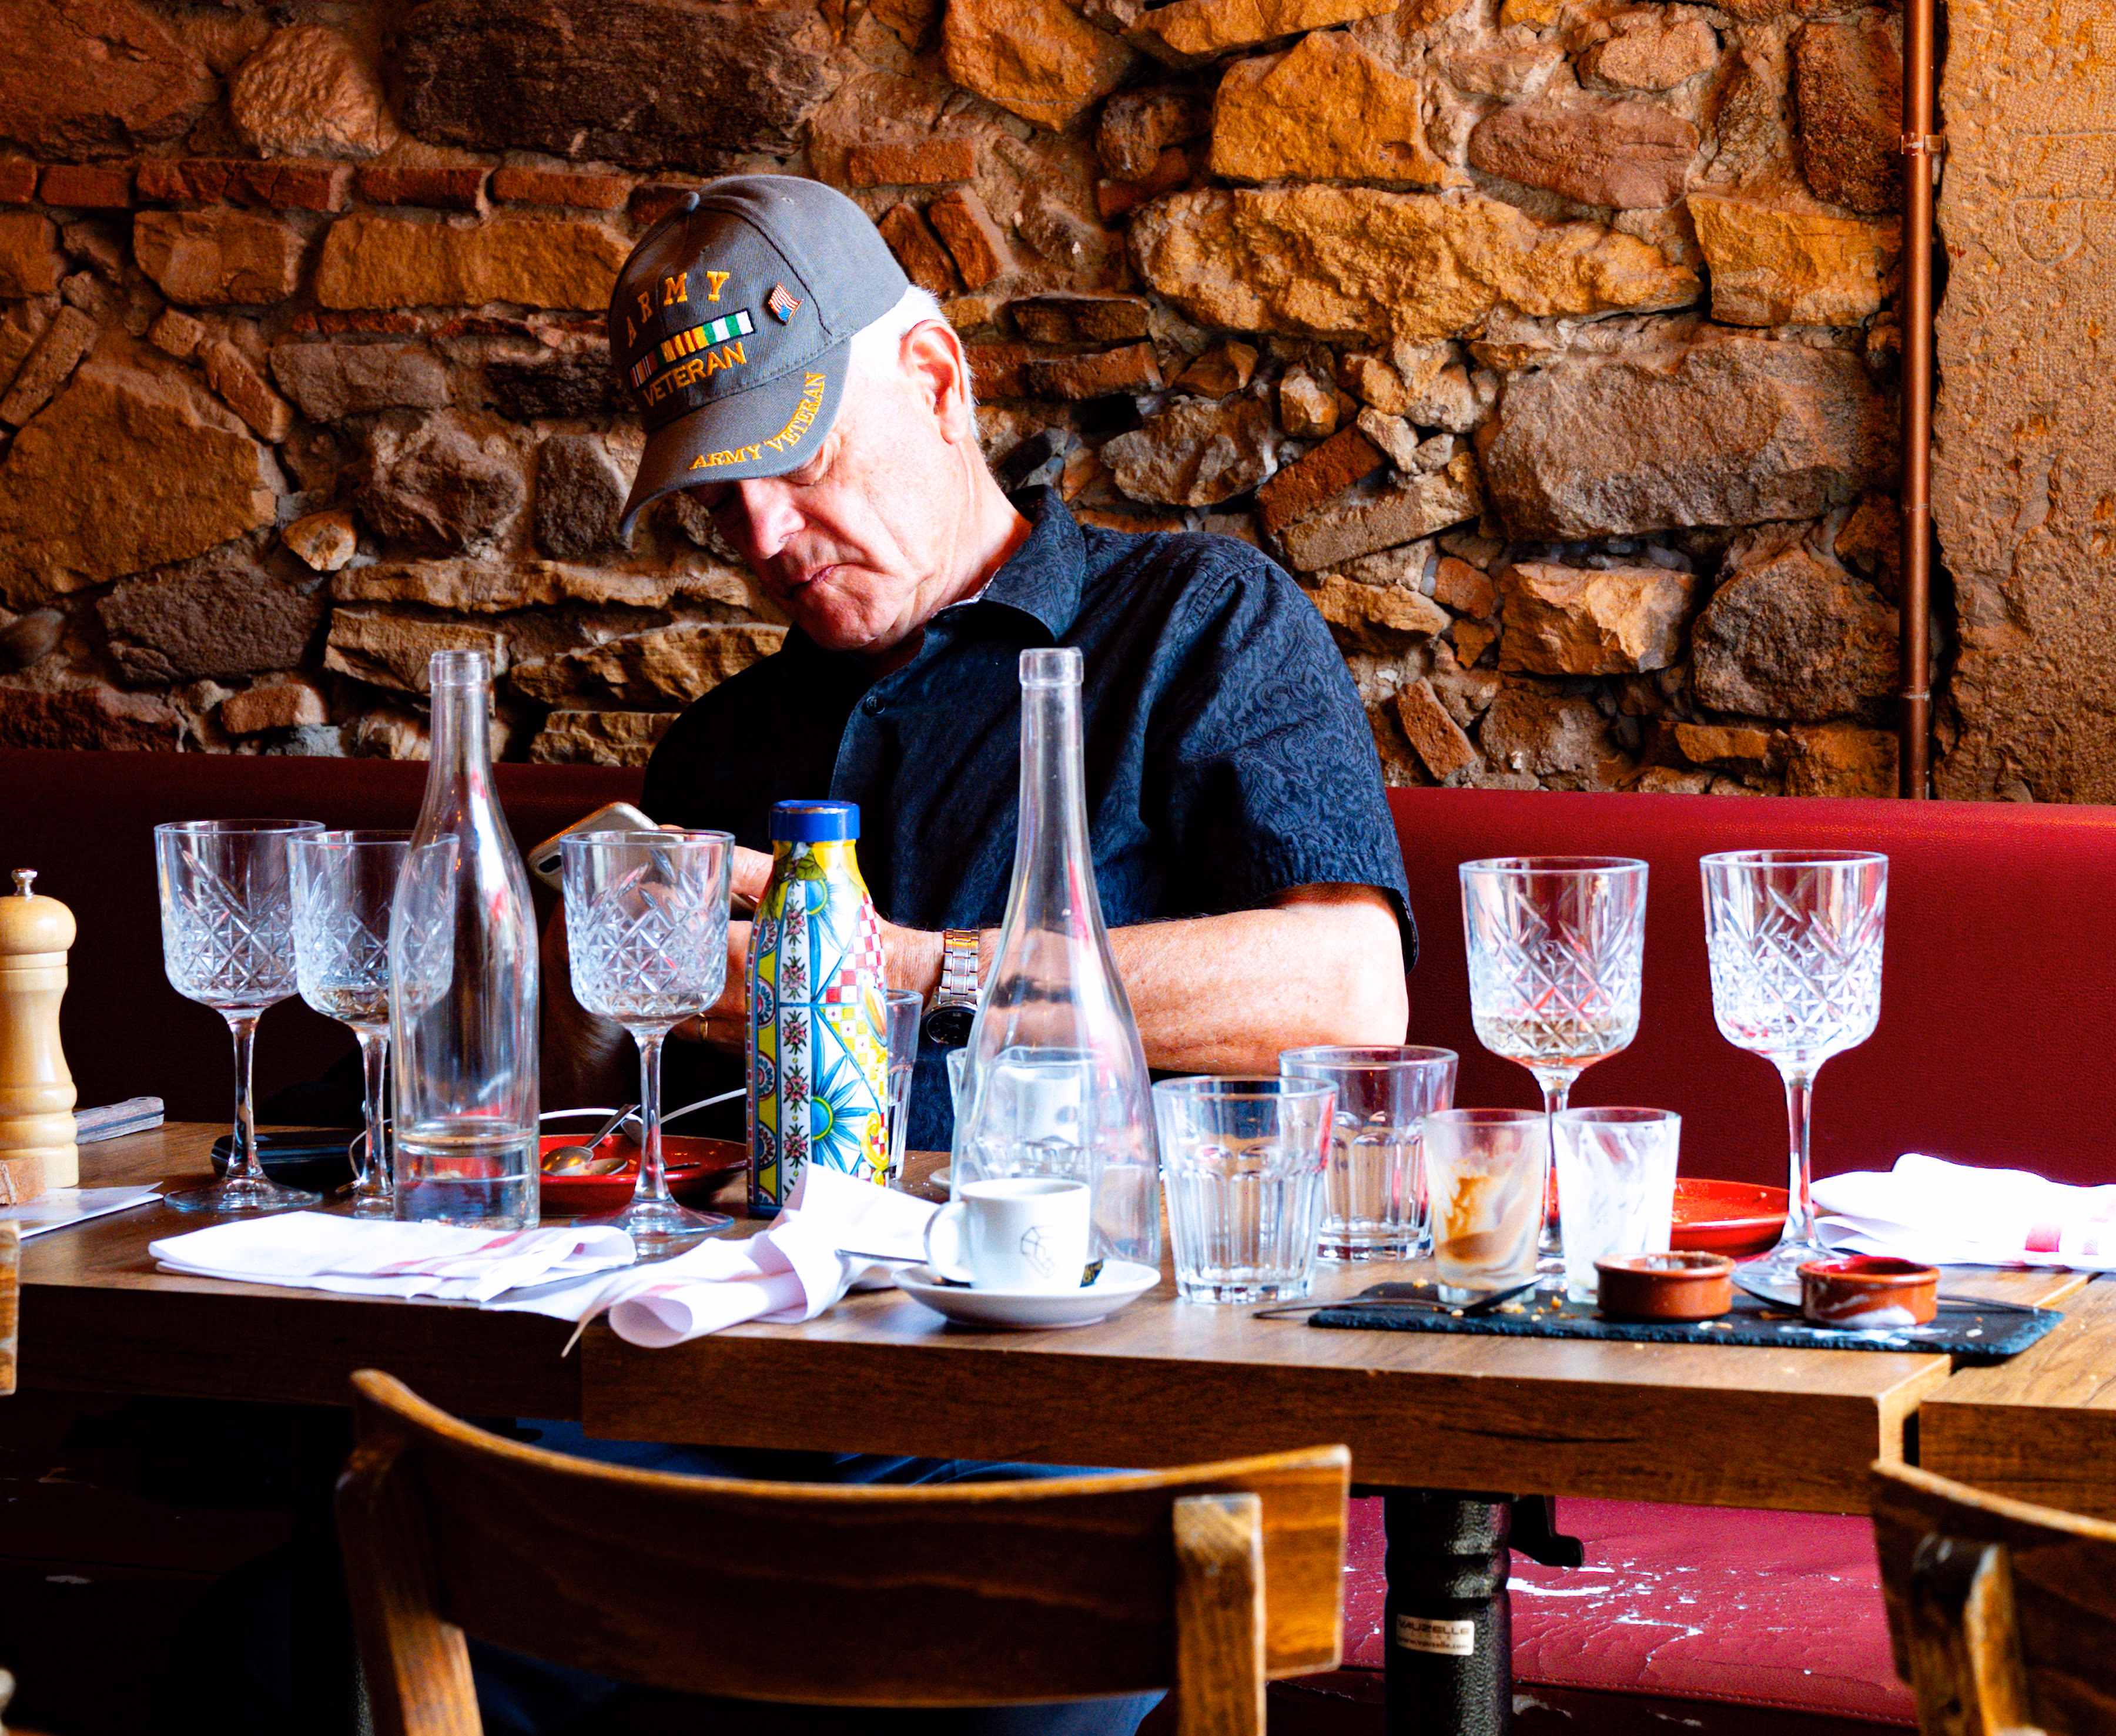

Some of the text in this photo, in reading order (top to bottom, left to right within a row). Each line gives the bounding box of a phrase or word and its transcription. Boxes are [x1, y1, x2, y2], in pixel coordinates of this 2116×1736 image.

[627, 270, 731, 348] ARMY
[643, 341, 747, 406] VETERAN
[689, 372, 826, 470] ARMY VETERAN
